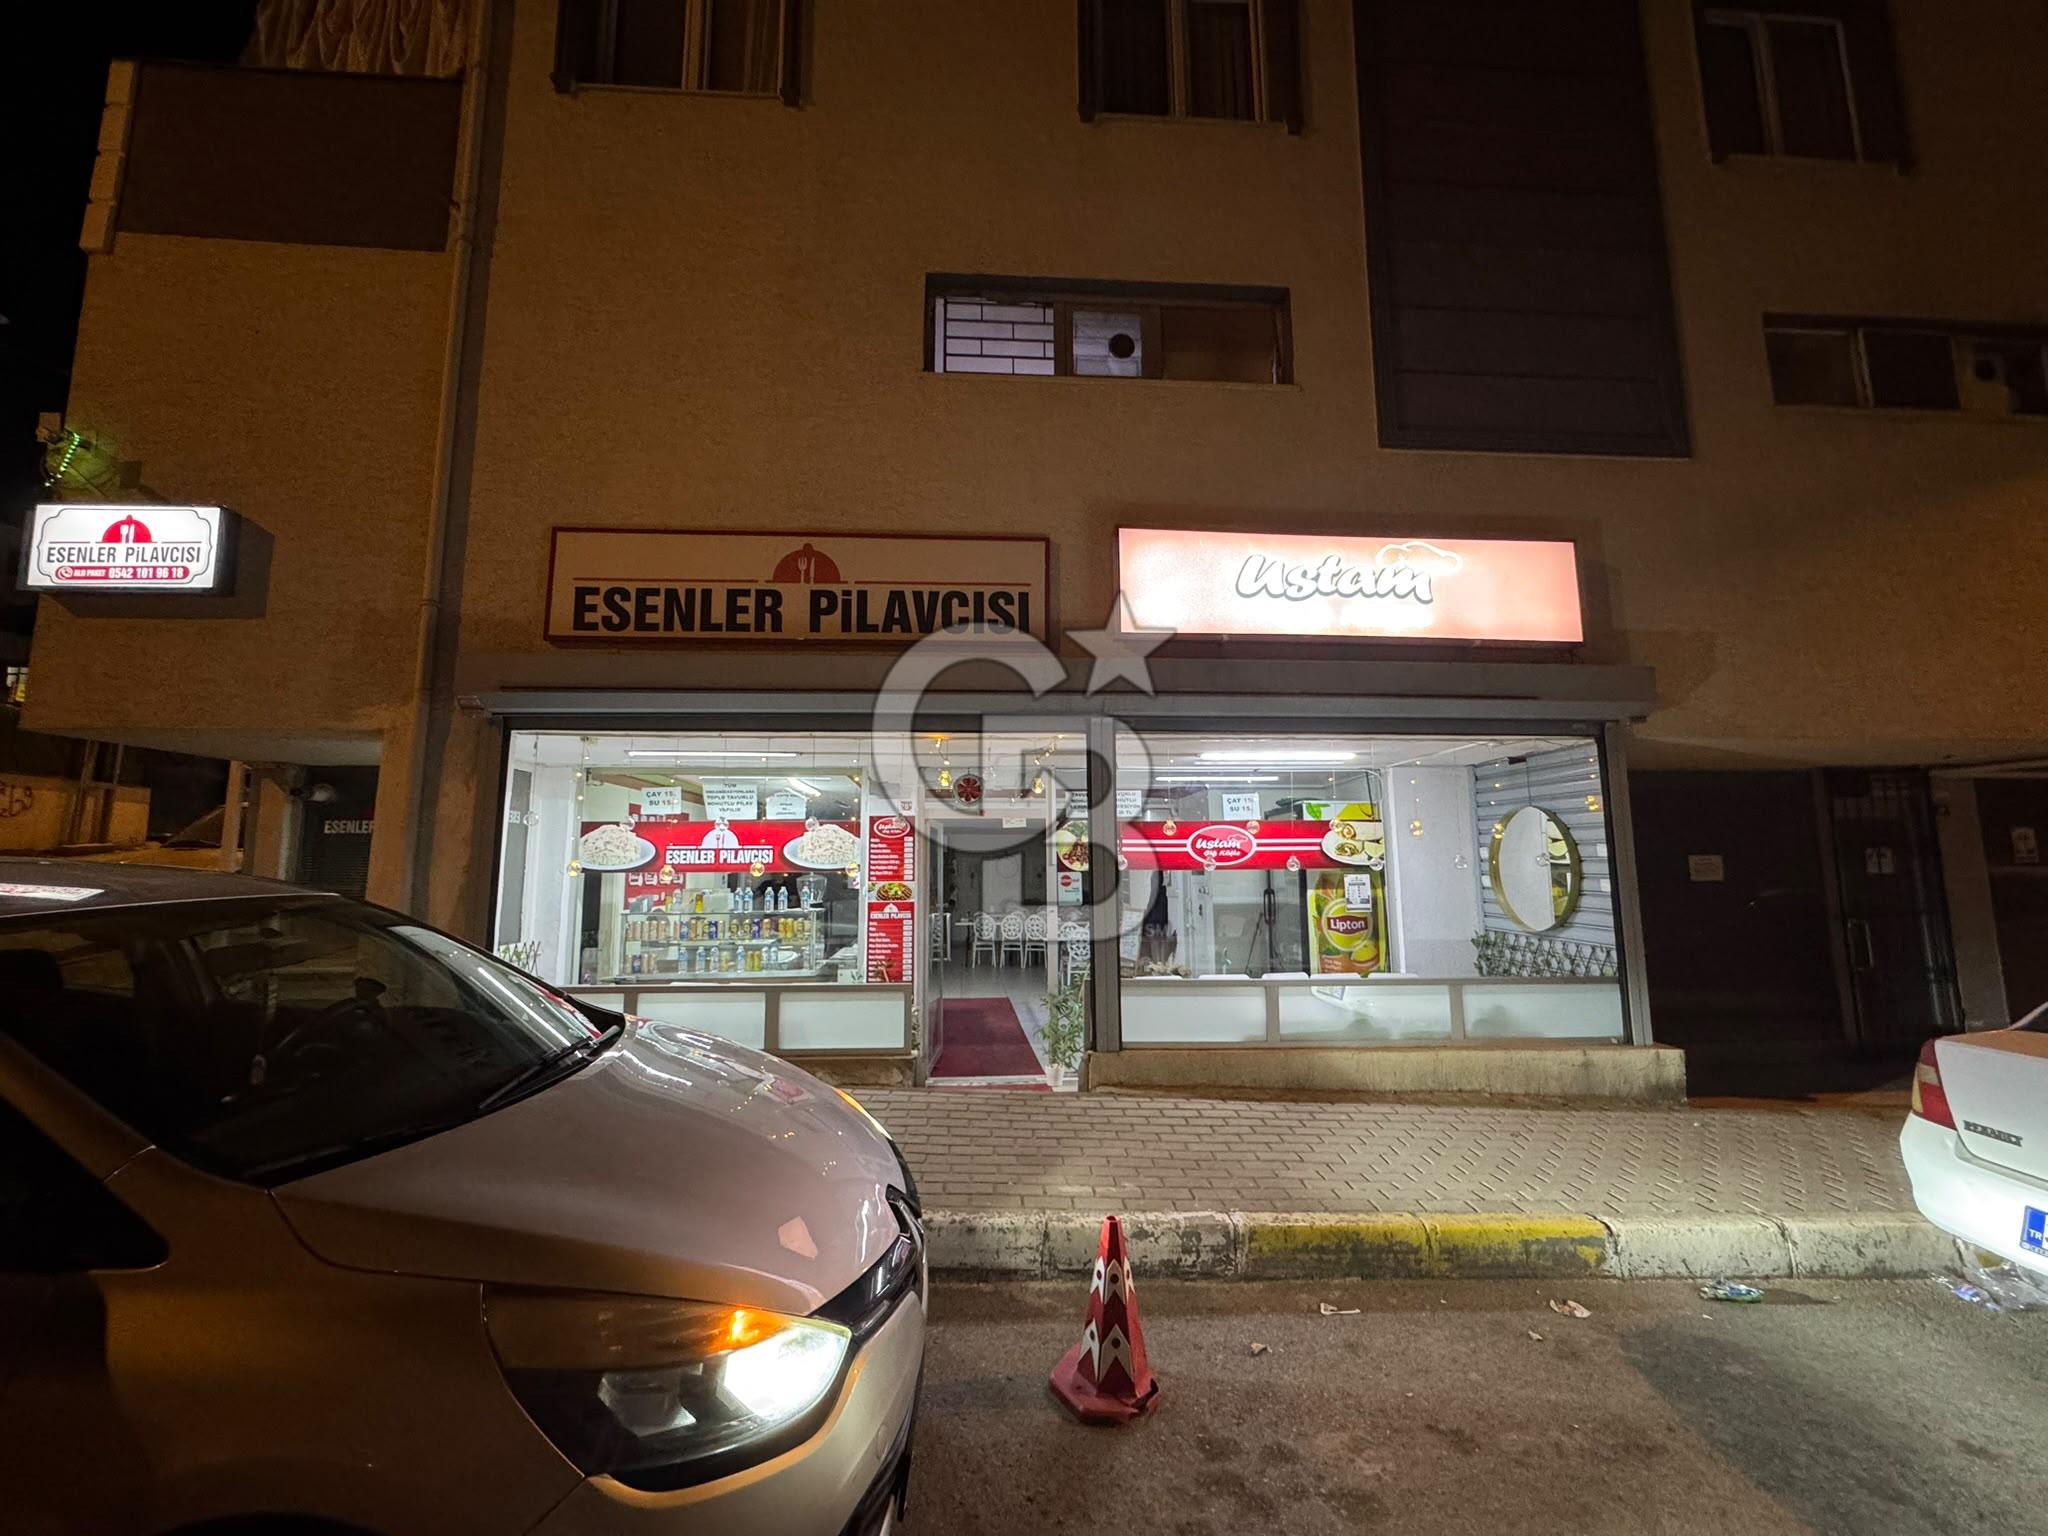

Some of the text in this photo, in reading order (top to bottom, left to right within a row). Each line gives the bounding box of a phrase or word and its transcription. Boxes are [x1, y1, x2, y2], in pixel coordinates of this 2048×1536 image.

[47, 546, 201, 563] ESENLER PiLAVCISI
[108, 567, 134, 579] 0542
[136, 568, 153, 579] 101
[171, 568, 184, 579] 18
[1235, 554, 1434, 604] Ustam
[573, 586, 1031, 634] ESENLER PiLAVCISI
[1195, 837, 1241, 850] Ustam
[666, 849, 715, 865] ESENLER
[1330, 918, 1366, 932] Lipton
[2029, 1228, 2043, 1241] TR
